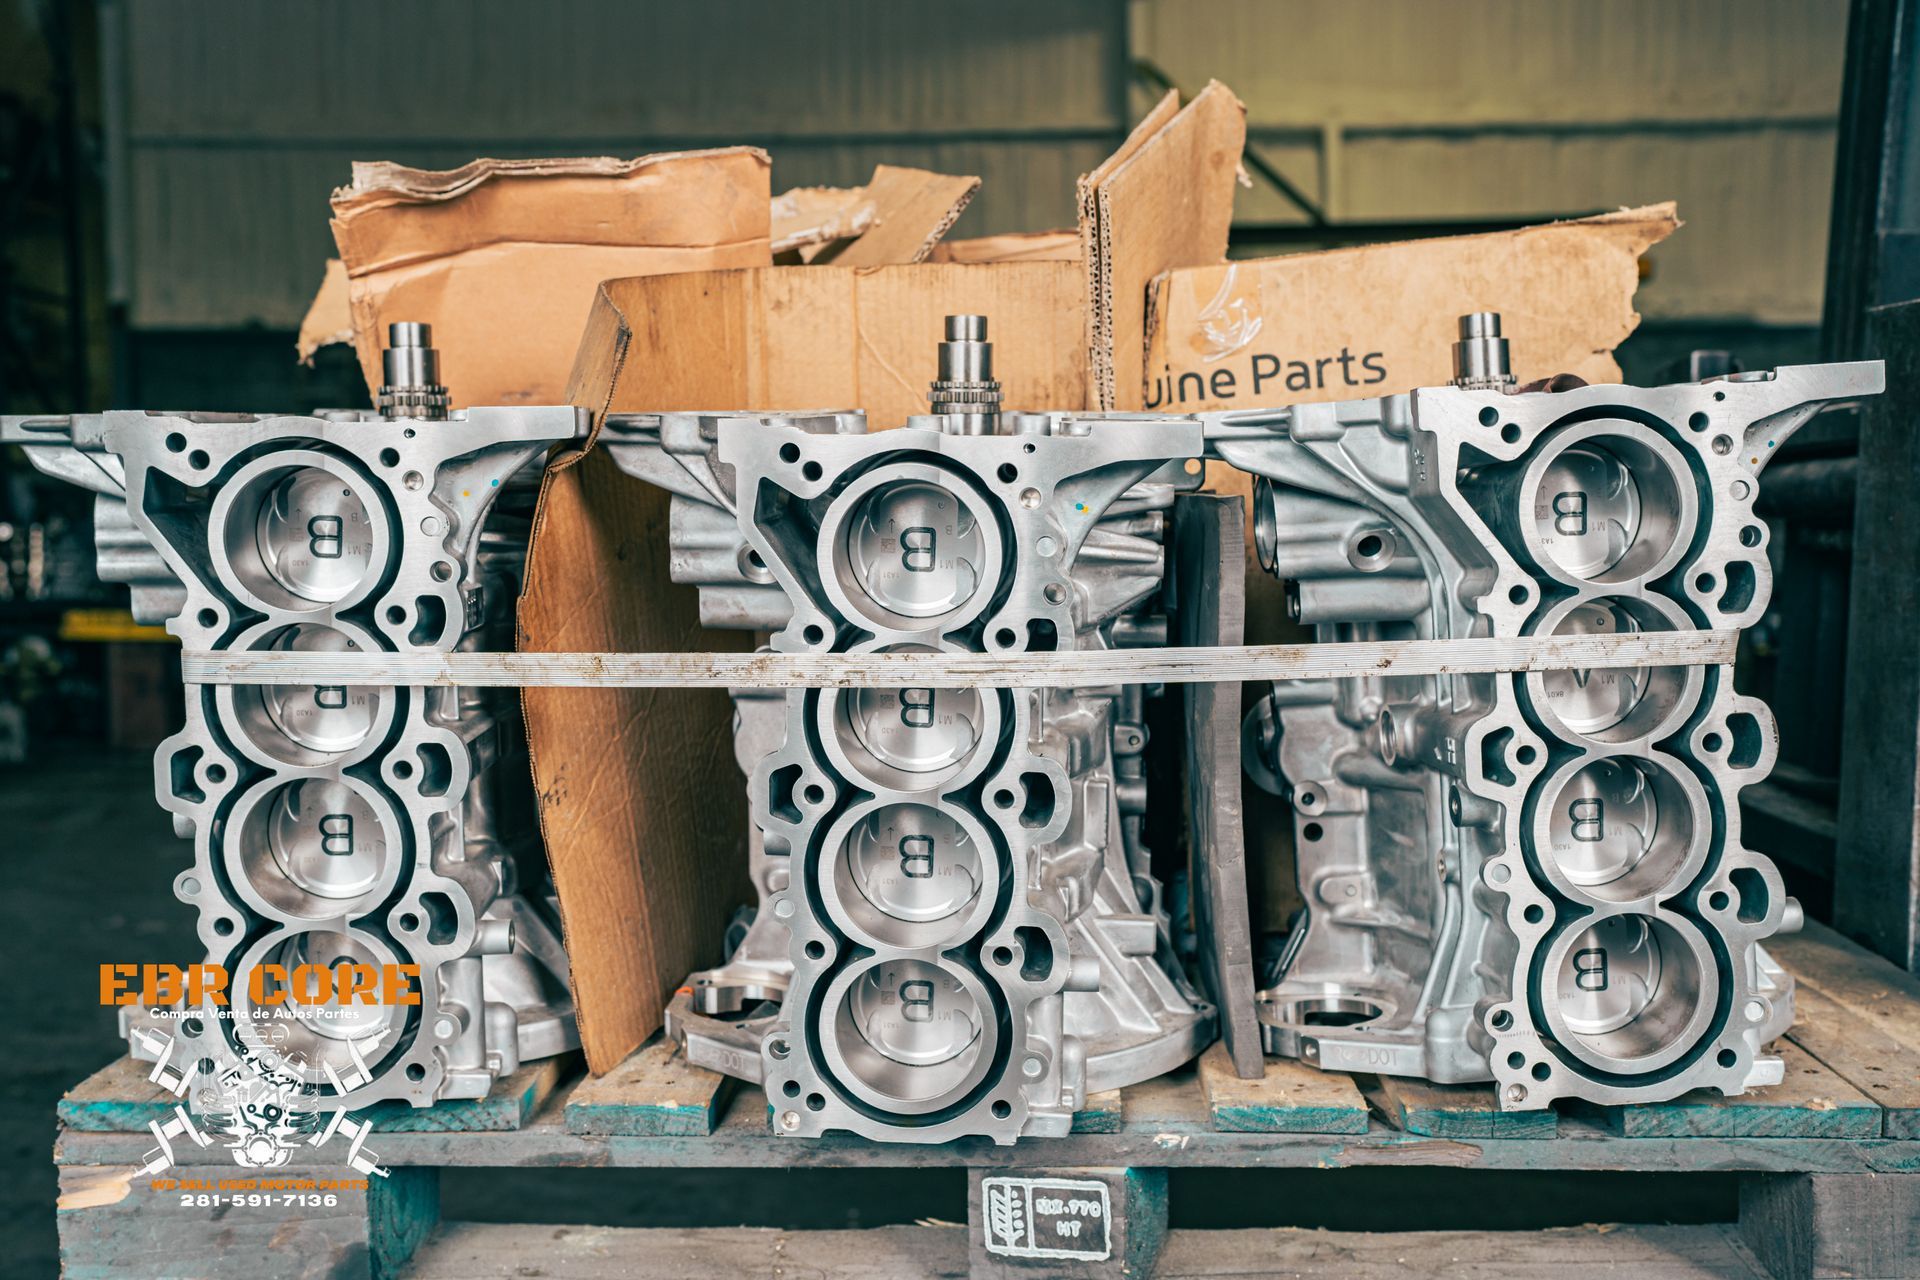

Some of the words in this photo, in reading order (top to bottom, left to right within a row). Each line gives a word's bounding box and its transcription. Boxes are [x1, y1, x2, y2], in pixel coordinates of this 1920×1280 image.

[1251, 347, 1387, 395] Parts
[1552, 491, 1588, 536] B
[307, 514, 343, 559] B
[900, 526, 936, 572] B
[899, 687, 935, 728] B
[319, 814, 354, 856] B
[1568, 798, 1604, 842] B
[899, 834, 935, 878] B
[1573, 948, 1609, 991] B
[899, 980, 934, 1023] B
[1057, 1221, 1082, 1238] HT
